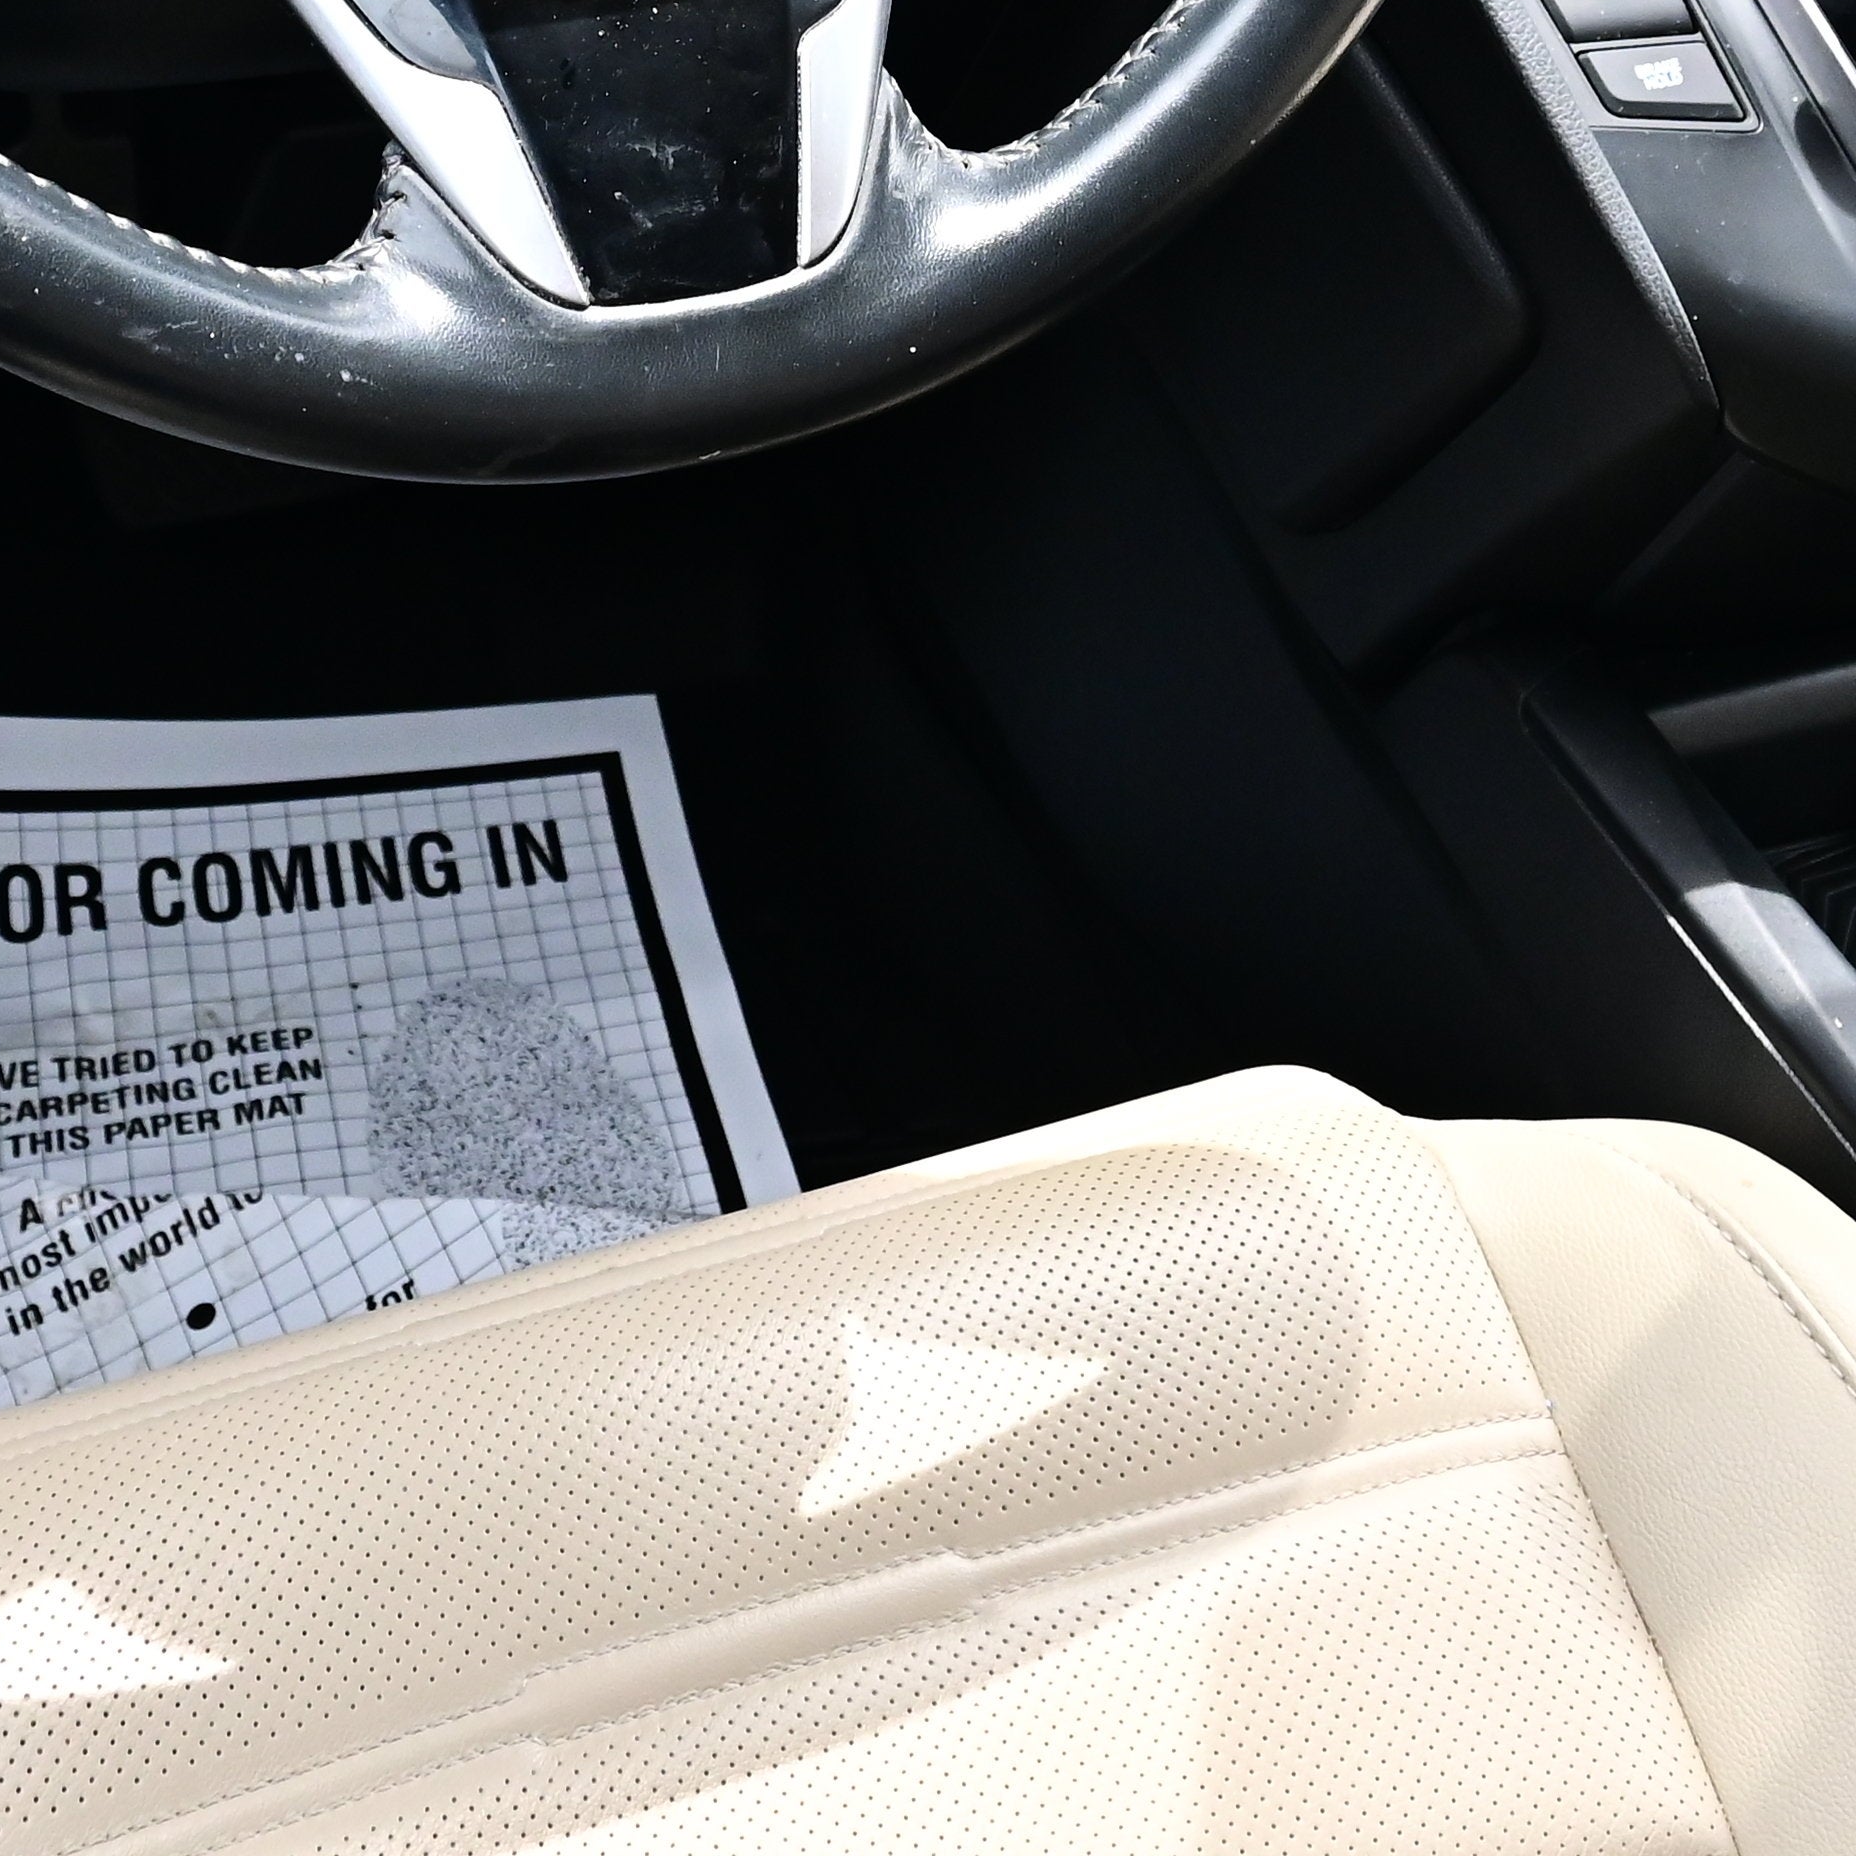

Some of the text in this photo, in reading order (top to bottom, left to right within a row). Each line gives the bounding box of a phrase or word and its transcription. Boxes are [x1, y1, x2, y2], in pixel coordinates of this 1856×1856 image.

[138, 828, 462, 930] COMING
[487, 818, 571, 888] IN
[51, 1047, 157, 1084] TRIED
[168, 1038, 214, 1068] TO
[226, 1026, 314, 1058] KEEP
[208, 1058, 323, 1096] CLEAN
[8, 1126, 90, 1160] THIS
[104, 1108, 220, 1146] PAPER
[234, 1092, 307, 1127] MAT
[19, 1197, 44, 1233] A
[5, 1302, 45, 1337] in
[51, 1265, 112, 1315] the
[119, 1197, 221, 1274] world
